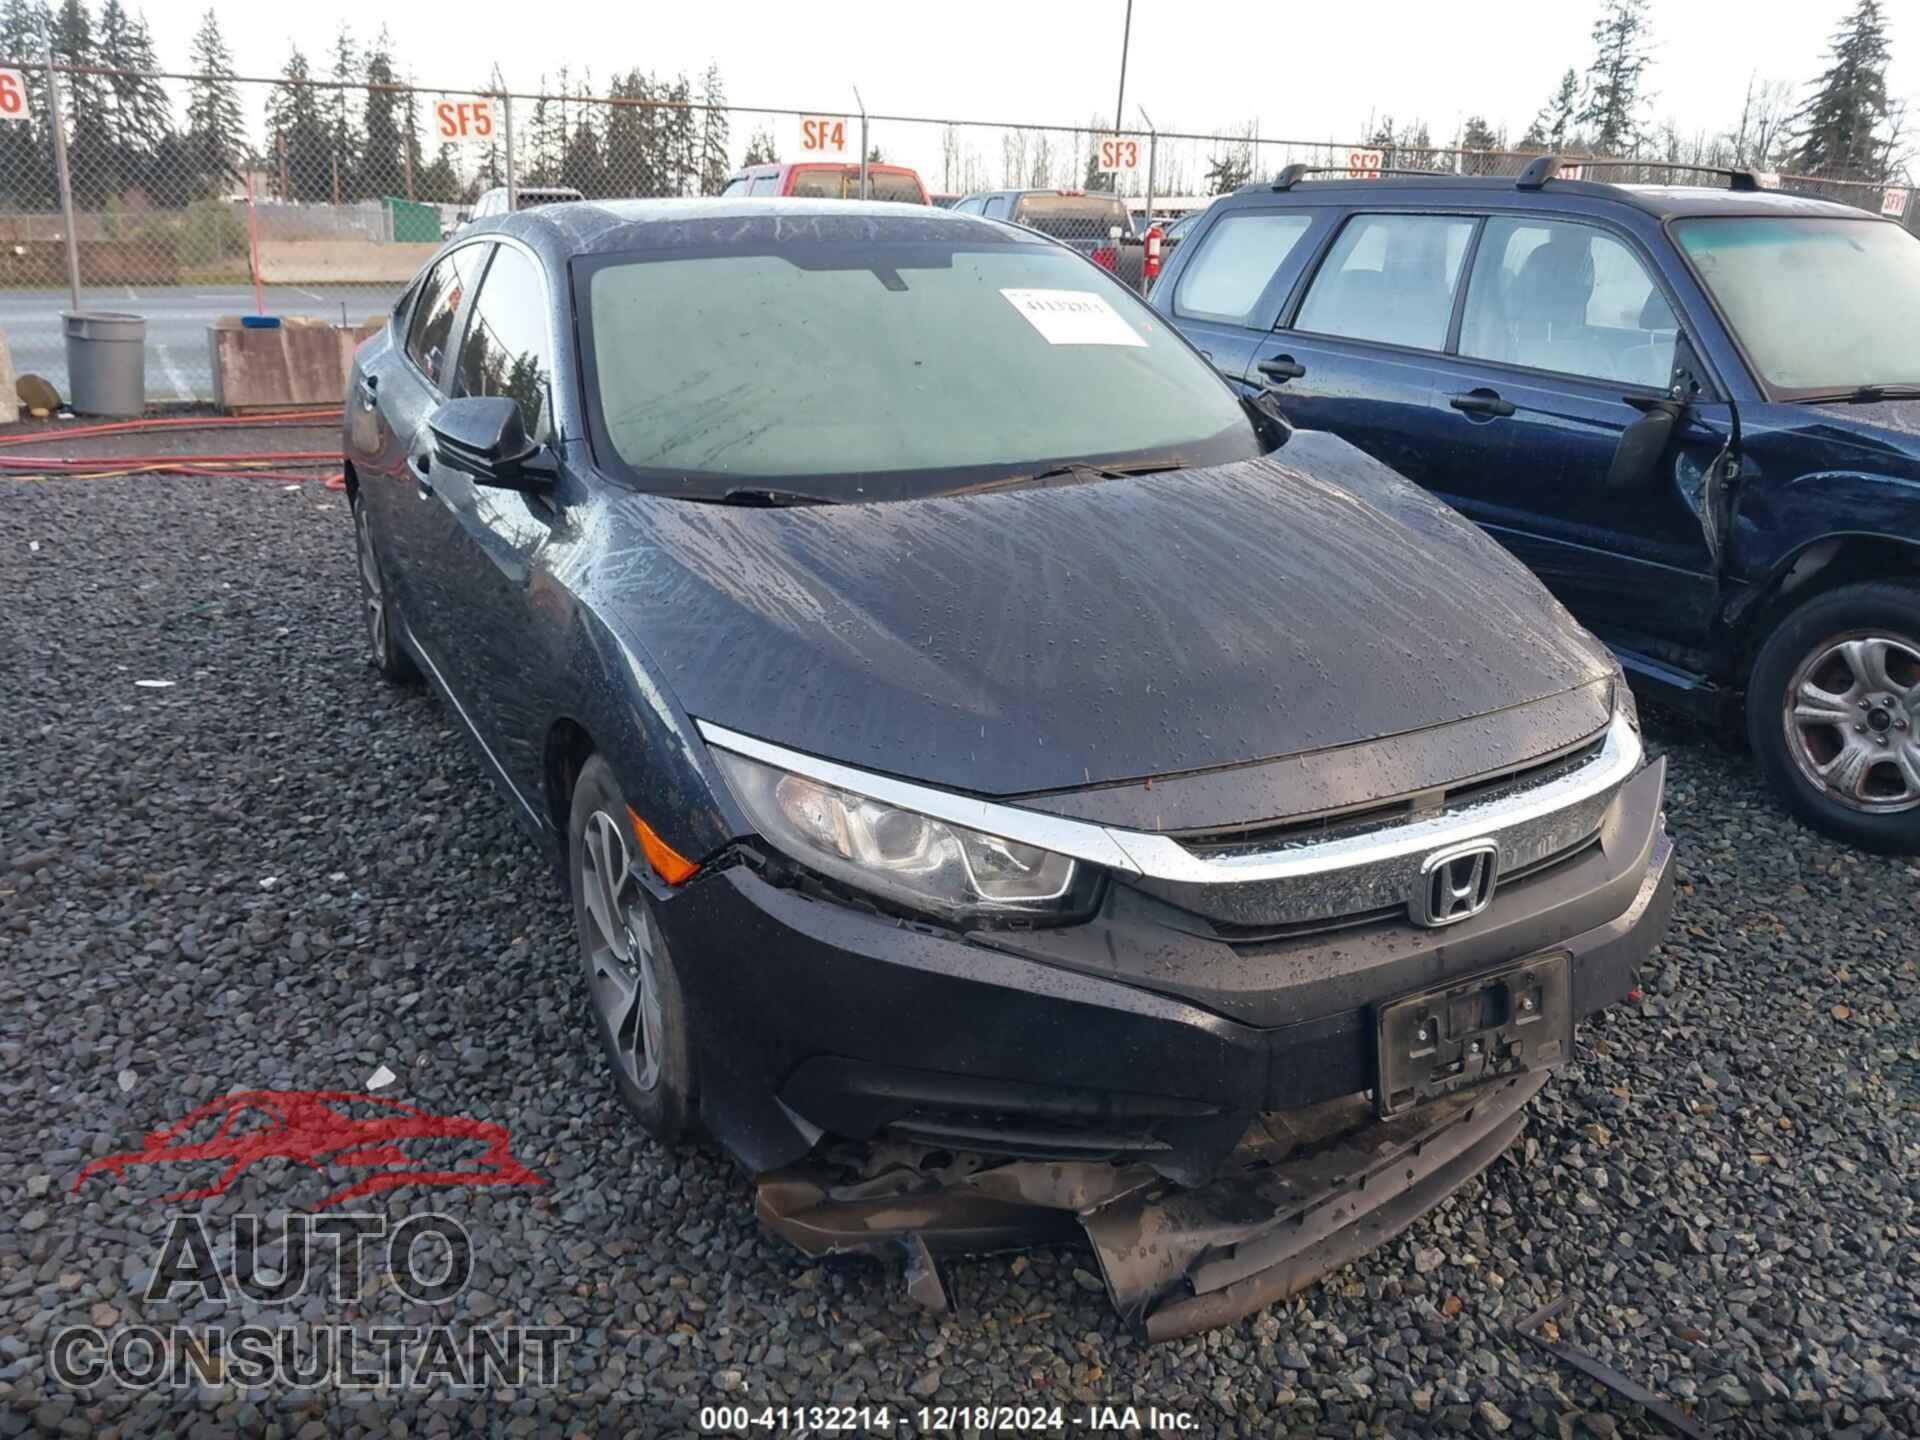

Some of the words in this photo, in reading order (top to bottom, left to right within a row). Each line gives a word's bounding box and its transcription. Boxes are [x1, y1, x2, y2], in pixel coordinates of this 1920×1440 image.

[0, 74, 21, 113] 6
[437, 103, 491, 137] SF5
[803, 120, 845, 151] SF4
[1102, 141, 1137, 168] SF3
[1350, 153, 1379, 178] SF2
